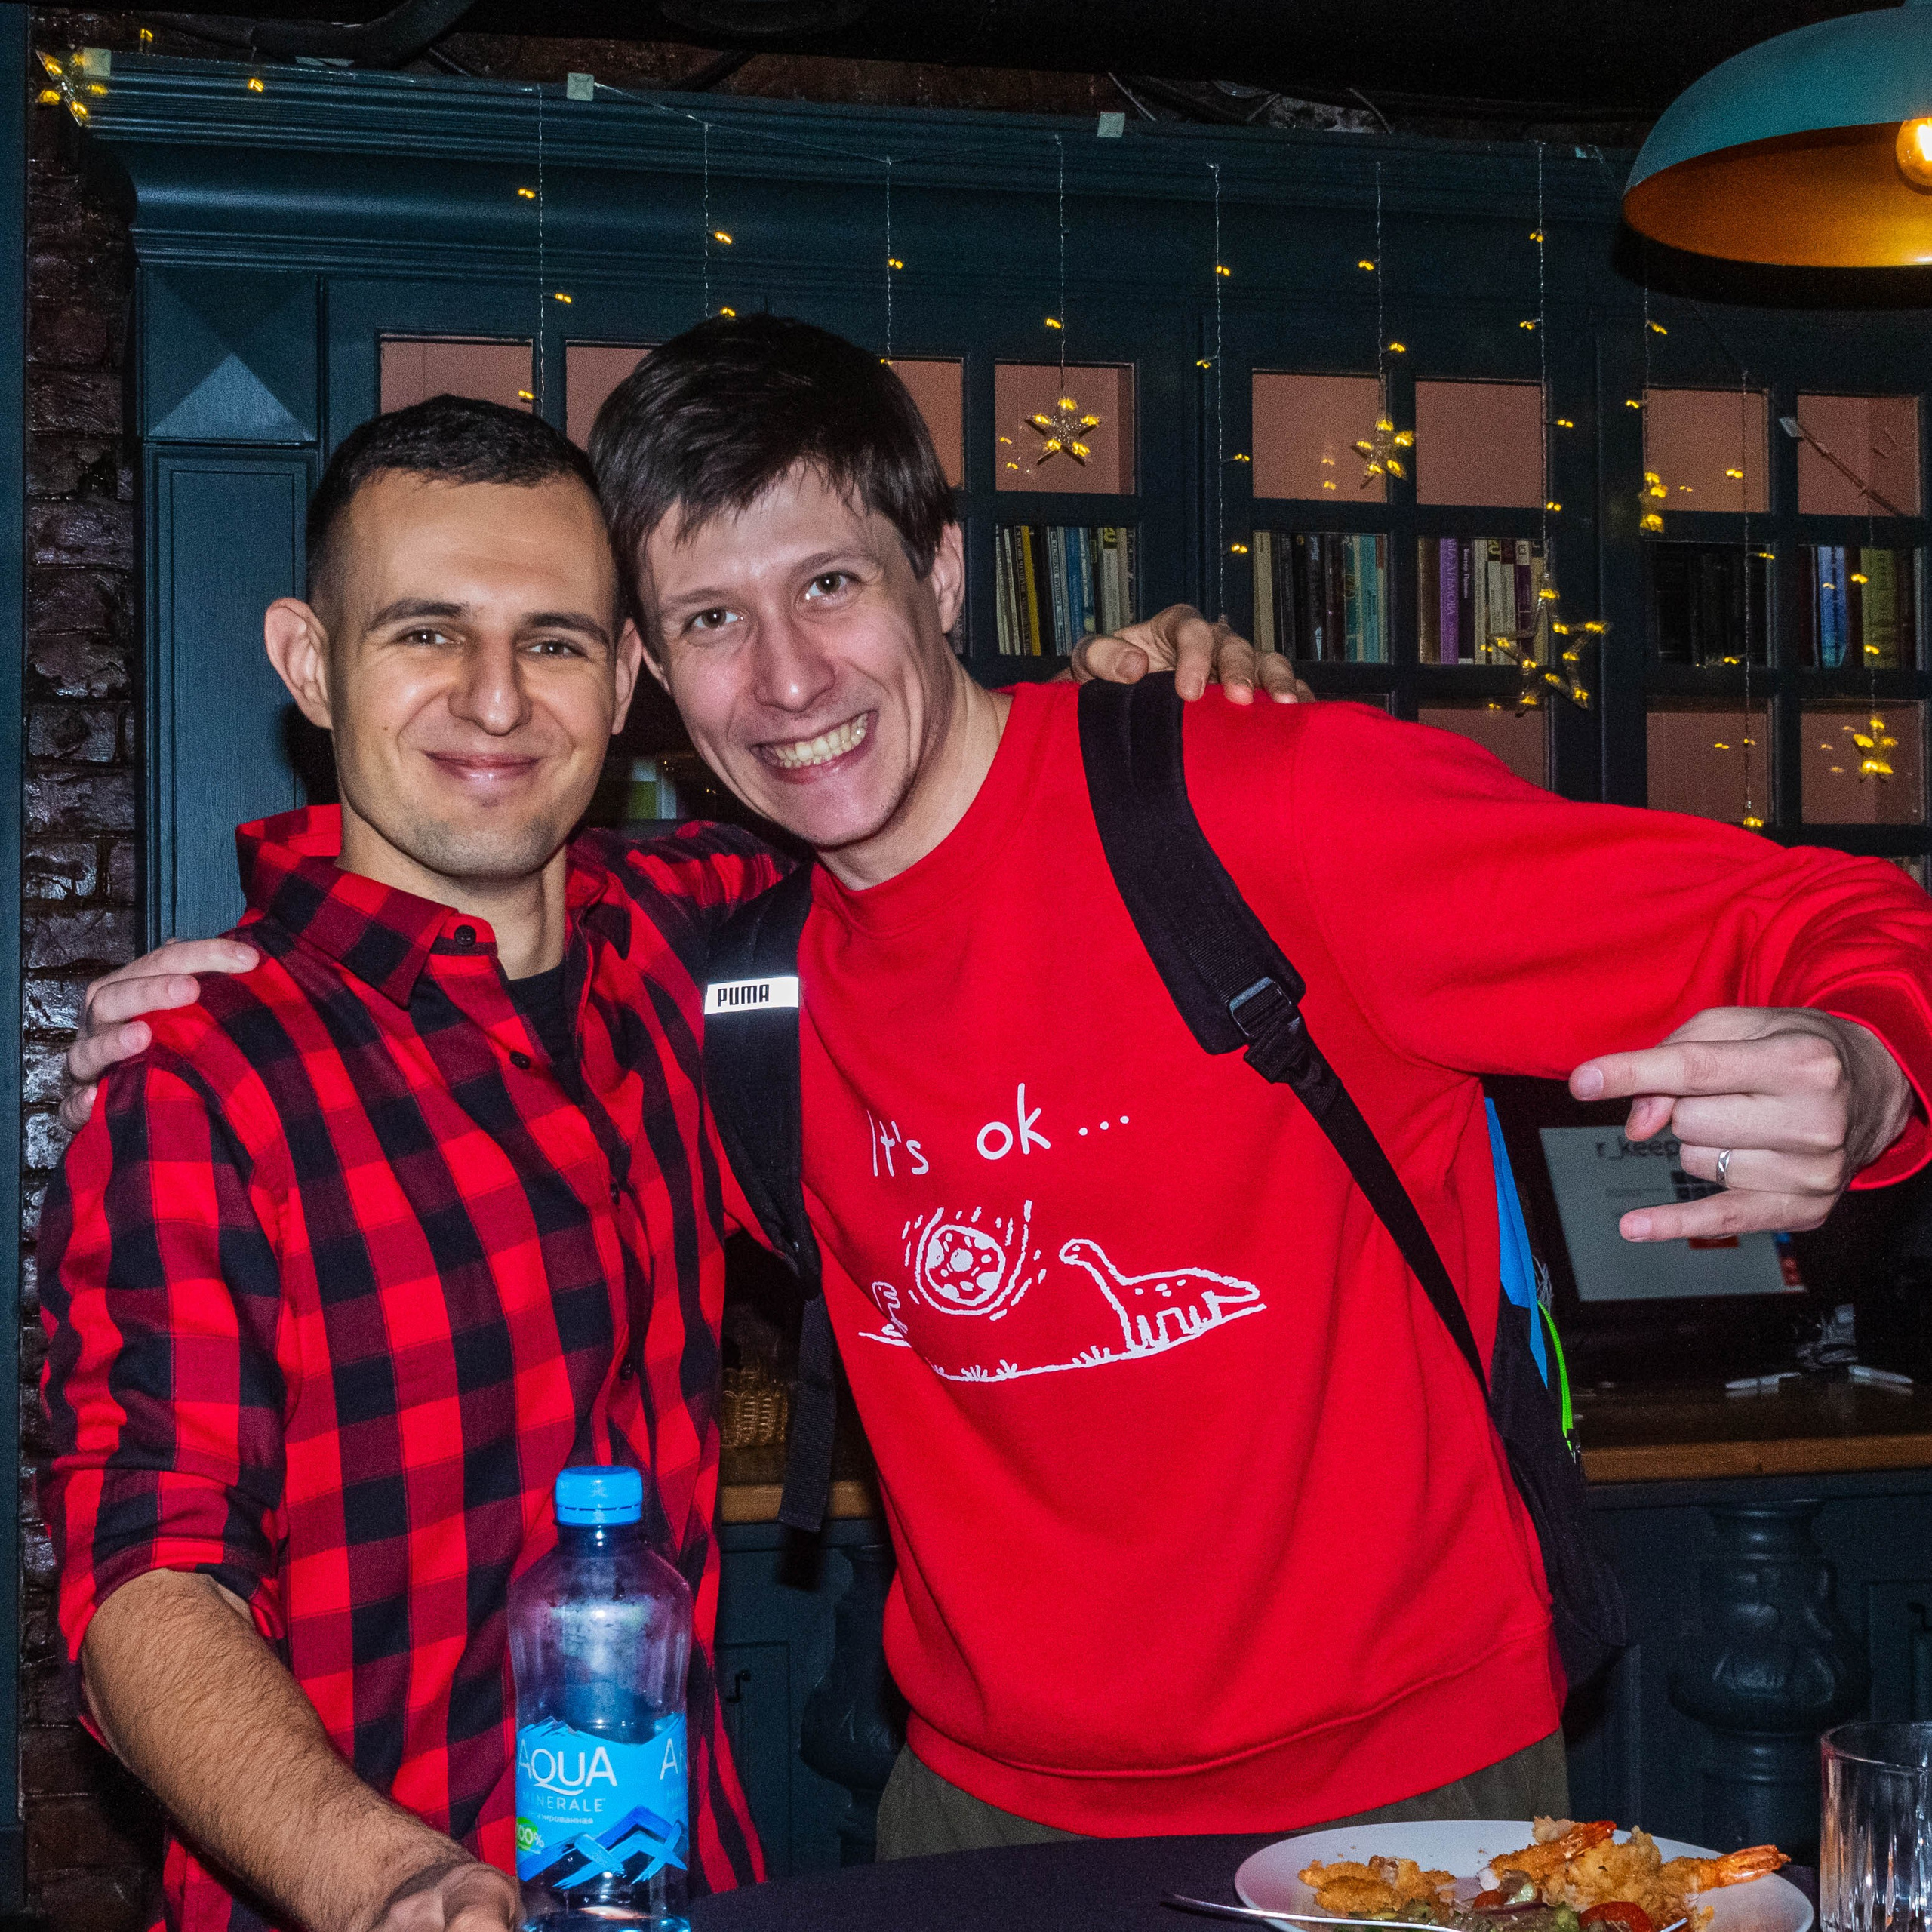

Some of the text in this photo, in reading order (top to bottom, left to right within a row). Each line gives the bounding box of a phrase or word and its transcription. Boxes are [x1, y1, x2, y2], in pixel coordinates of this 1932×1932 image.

[717, 983, 770, 1008] PUMA
[866, 1109, 930, 1177] It's
[976, 1082, 1051, 1161] ok
[518, 1738, 618, 1796] AQUA
[516, 1825, 545, 1848] 00%
